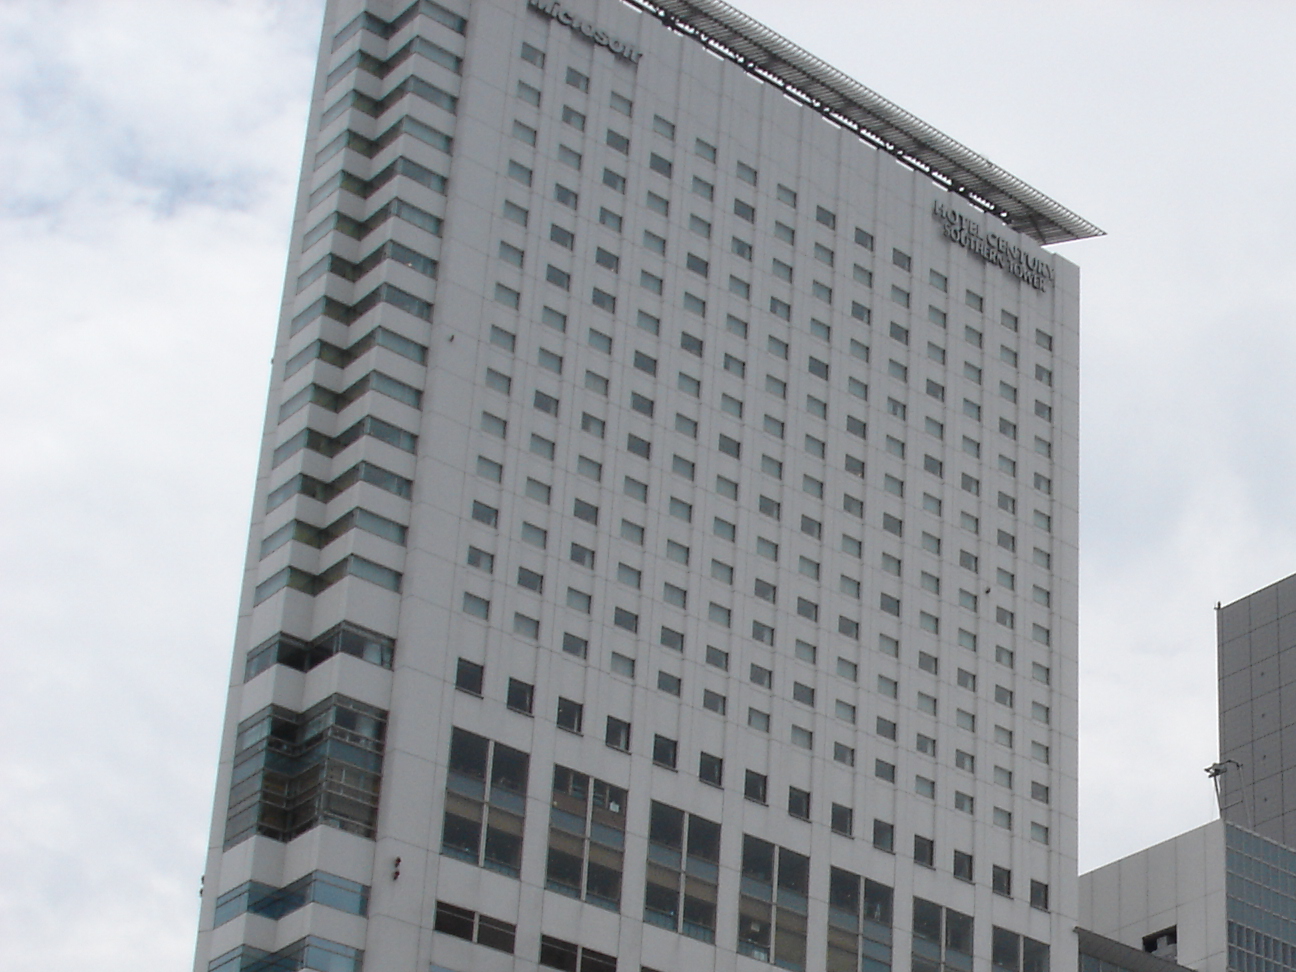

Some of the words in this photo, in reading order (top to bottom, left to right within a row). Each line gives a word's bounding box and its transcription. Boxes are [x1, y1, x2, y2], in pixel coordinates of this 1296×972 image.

[933, 199, 983, 241] HOTEL
[986, 233, 1055, 281] CENTURY
[943, 222, 1005, 269] SOUTHERN
[1007, 259, 1046, 293] TOWER
